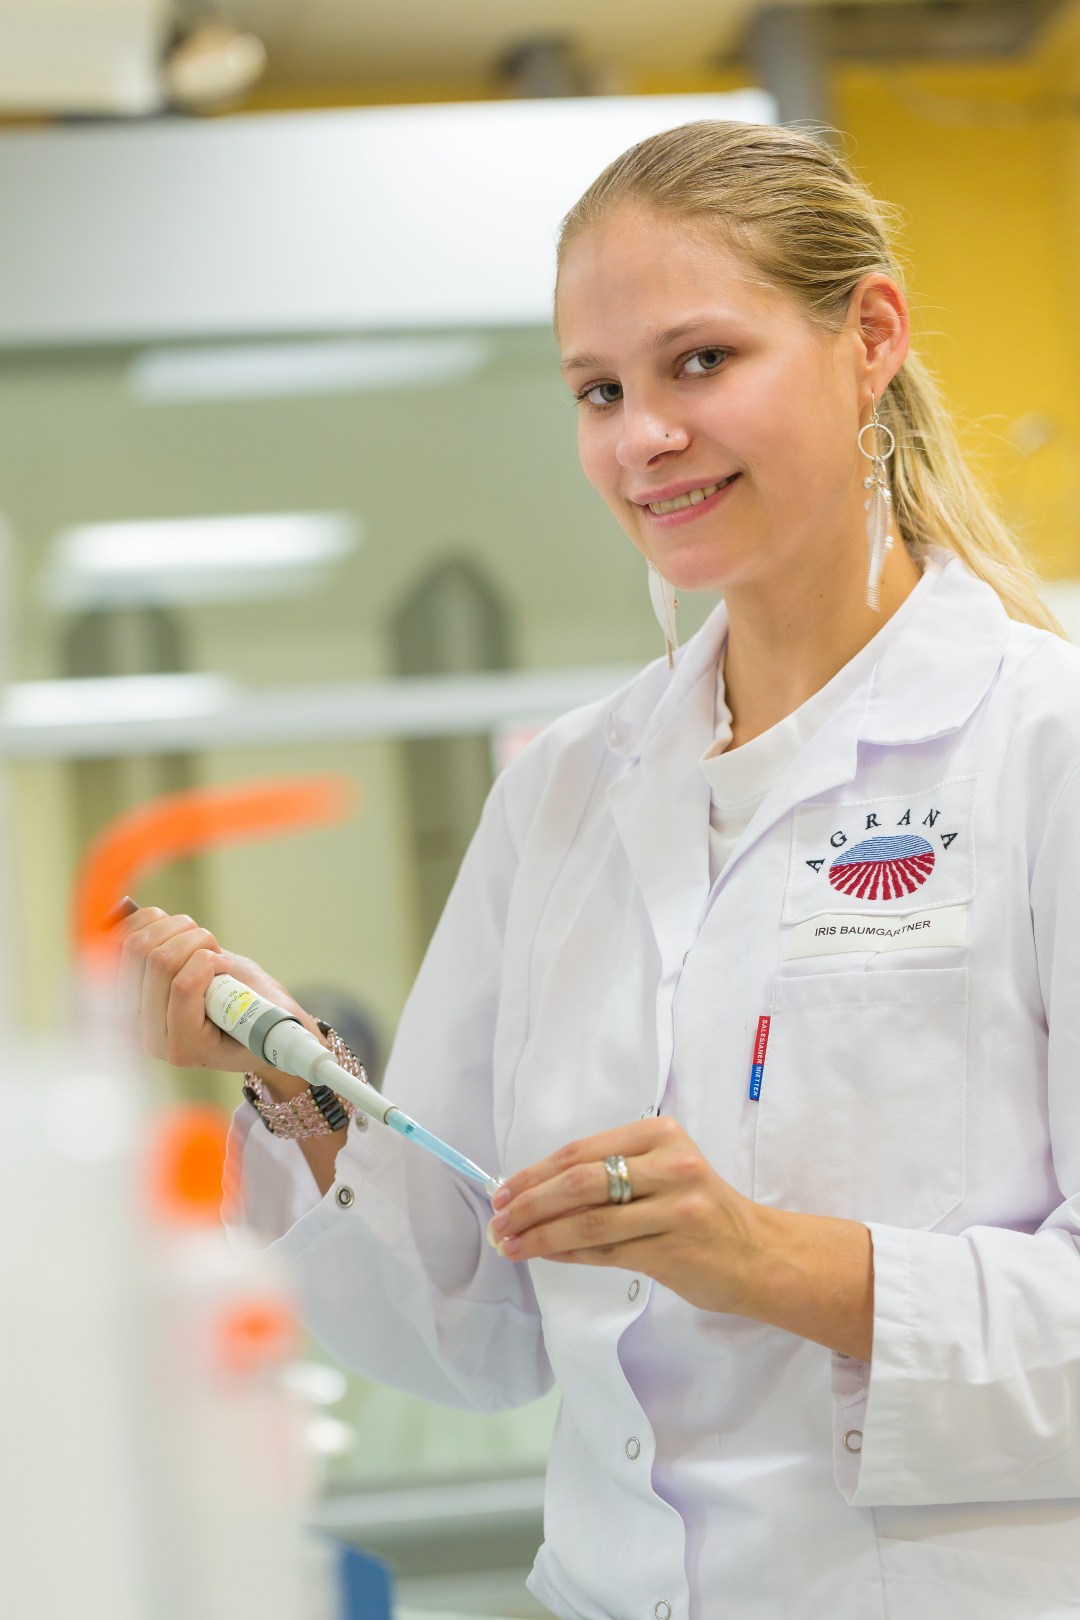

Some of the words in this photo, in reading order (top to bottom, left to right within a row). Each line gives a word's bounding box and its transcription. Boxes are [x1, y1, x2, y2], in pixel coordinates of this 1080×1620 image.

[805, 808, 958, 873] AGRANA
[814, 926, 837, 937] IRIS
[840, 920, 931, 938] BAUMGARTNER
[757, 1019, 768, 1064] SALESIANER
